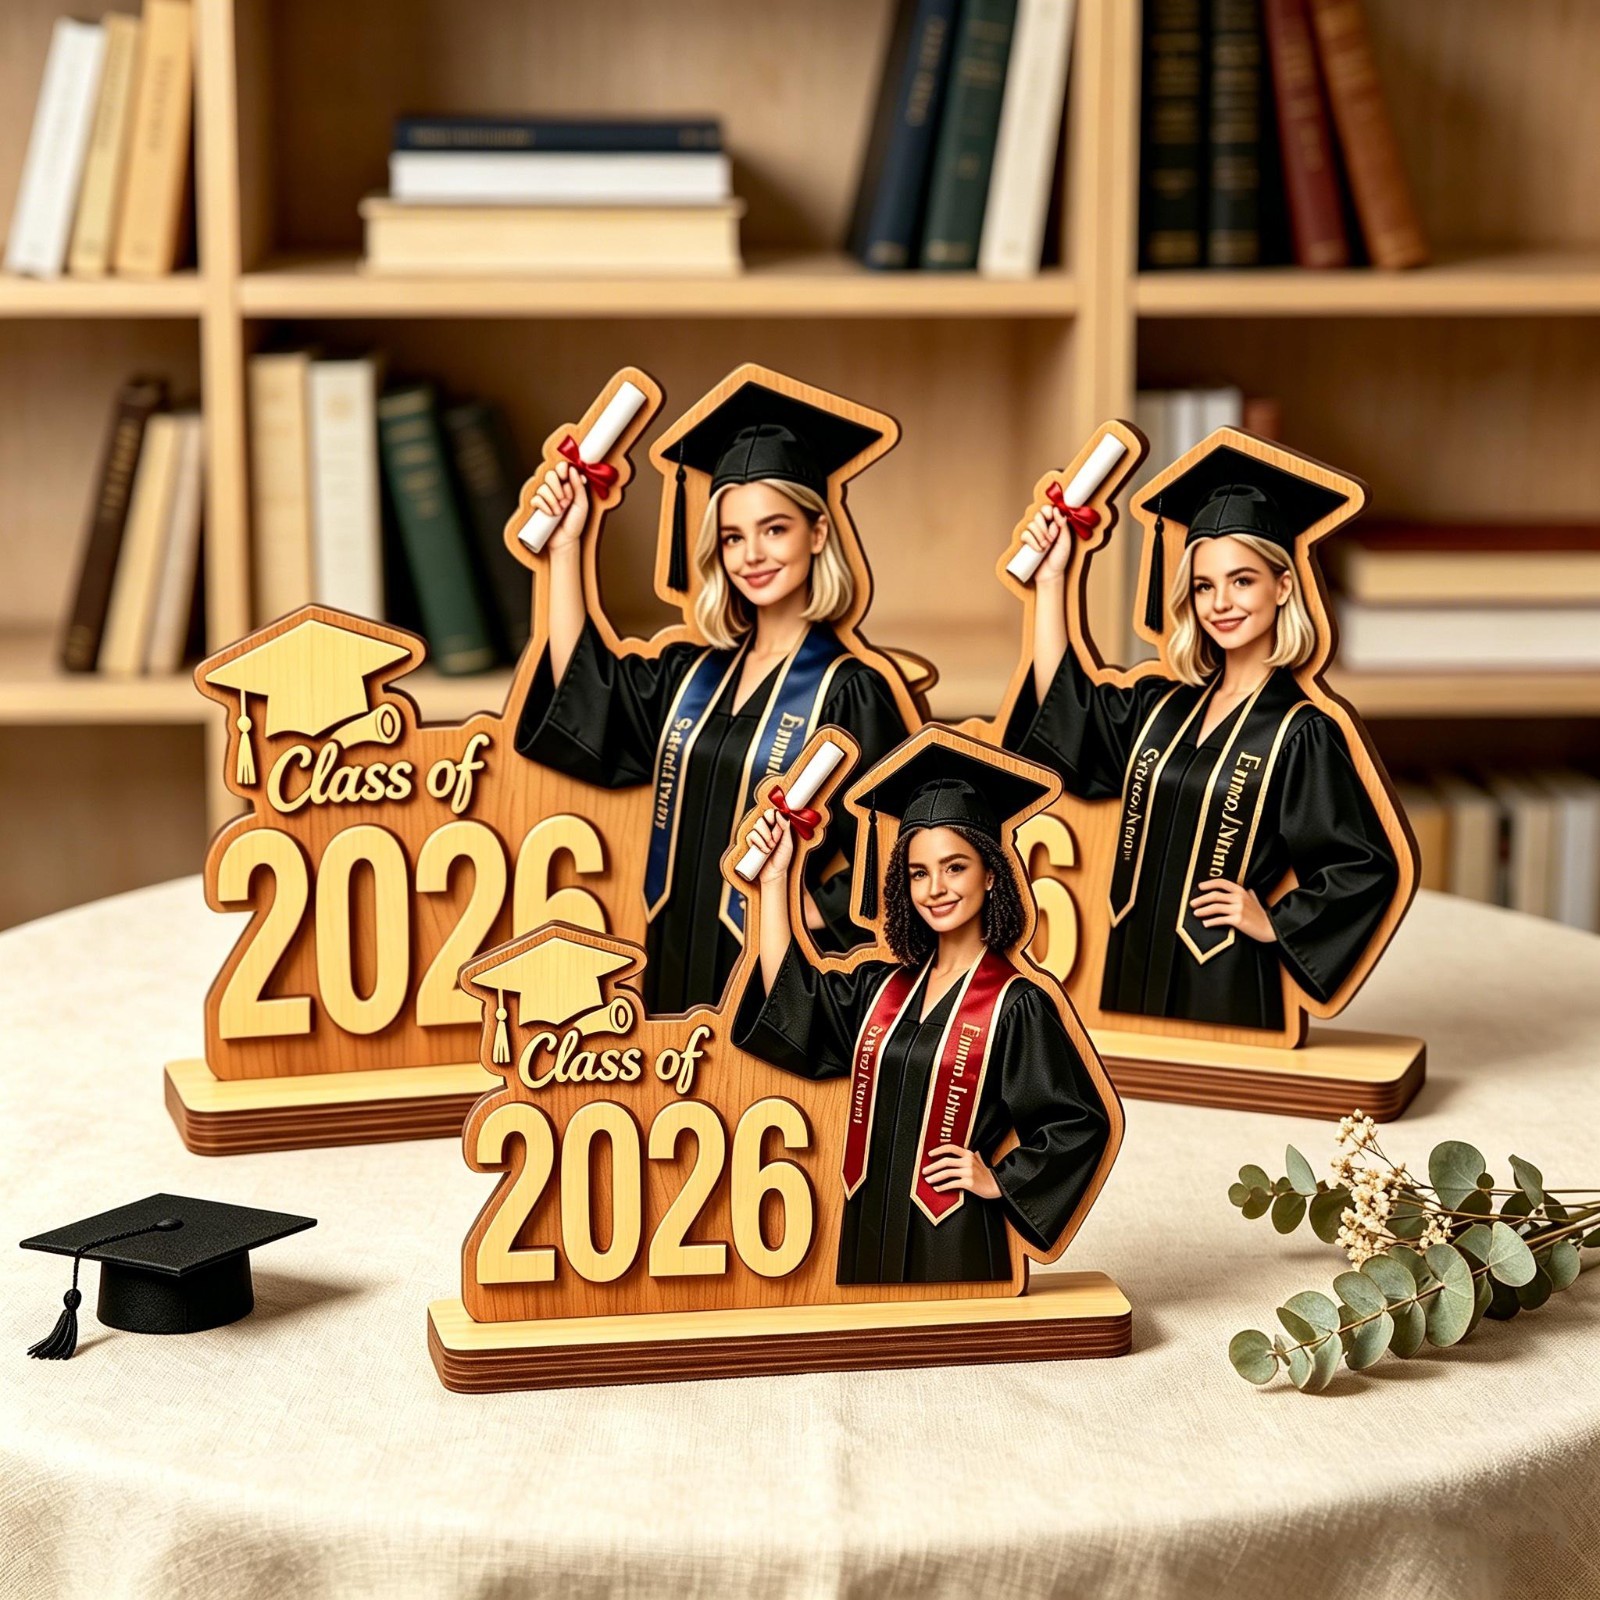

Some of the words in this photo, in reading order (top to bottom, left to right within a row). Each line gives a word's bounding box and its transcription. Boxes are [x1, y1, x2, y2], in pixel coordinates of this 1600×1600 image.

[267, 741, 413, 813] Class
[426, 733, 491, 815] of
[217, 813, 607, 1039] 2026
[518, 1029, 642, 1089] Class
[655, 1024, 711, 1095] of
[476, 1098, 814, 1285] 2026
